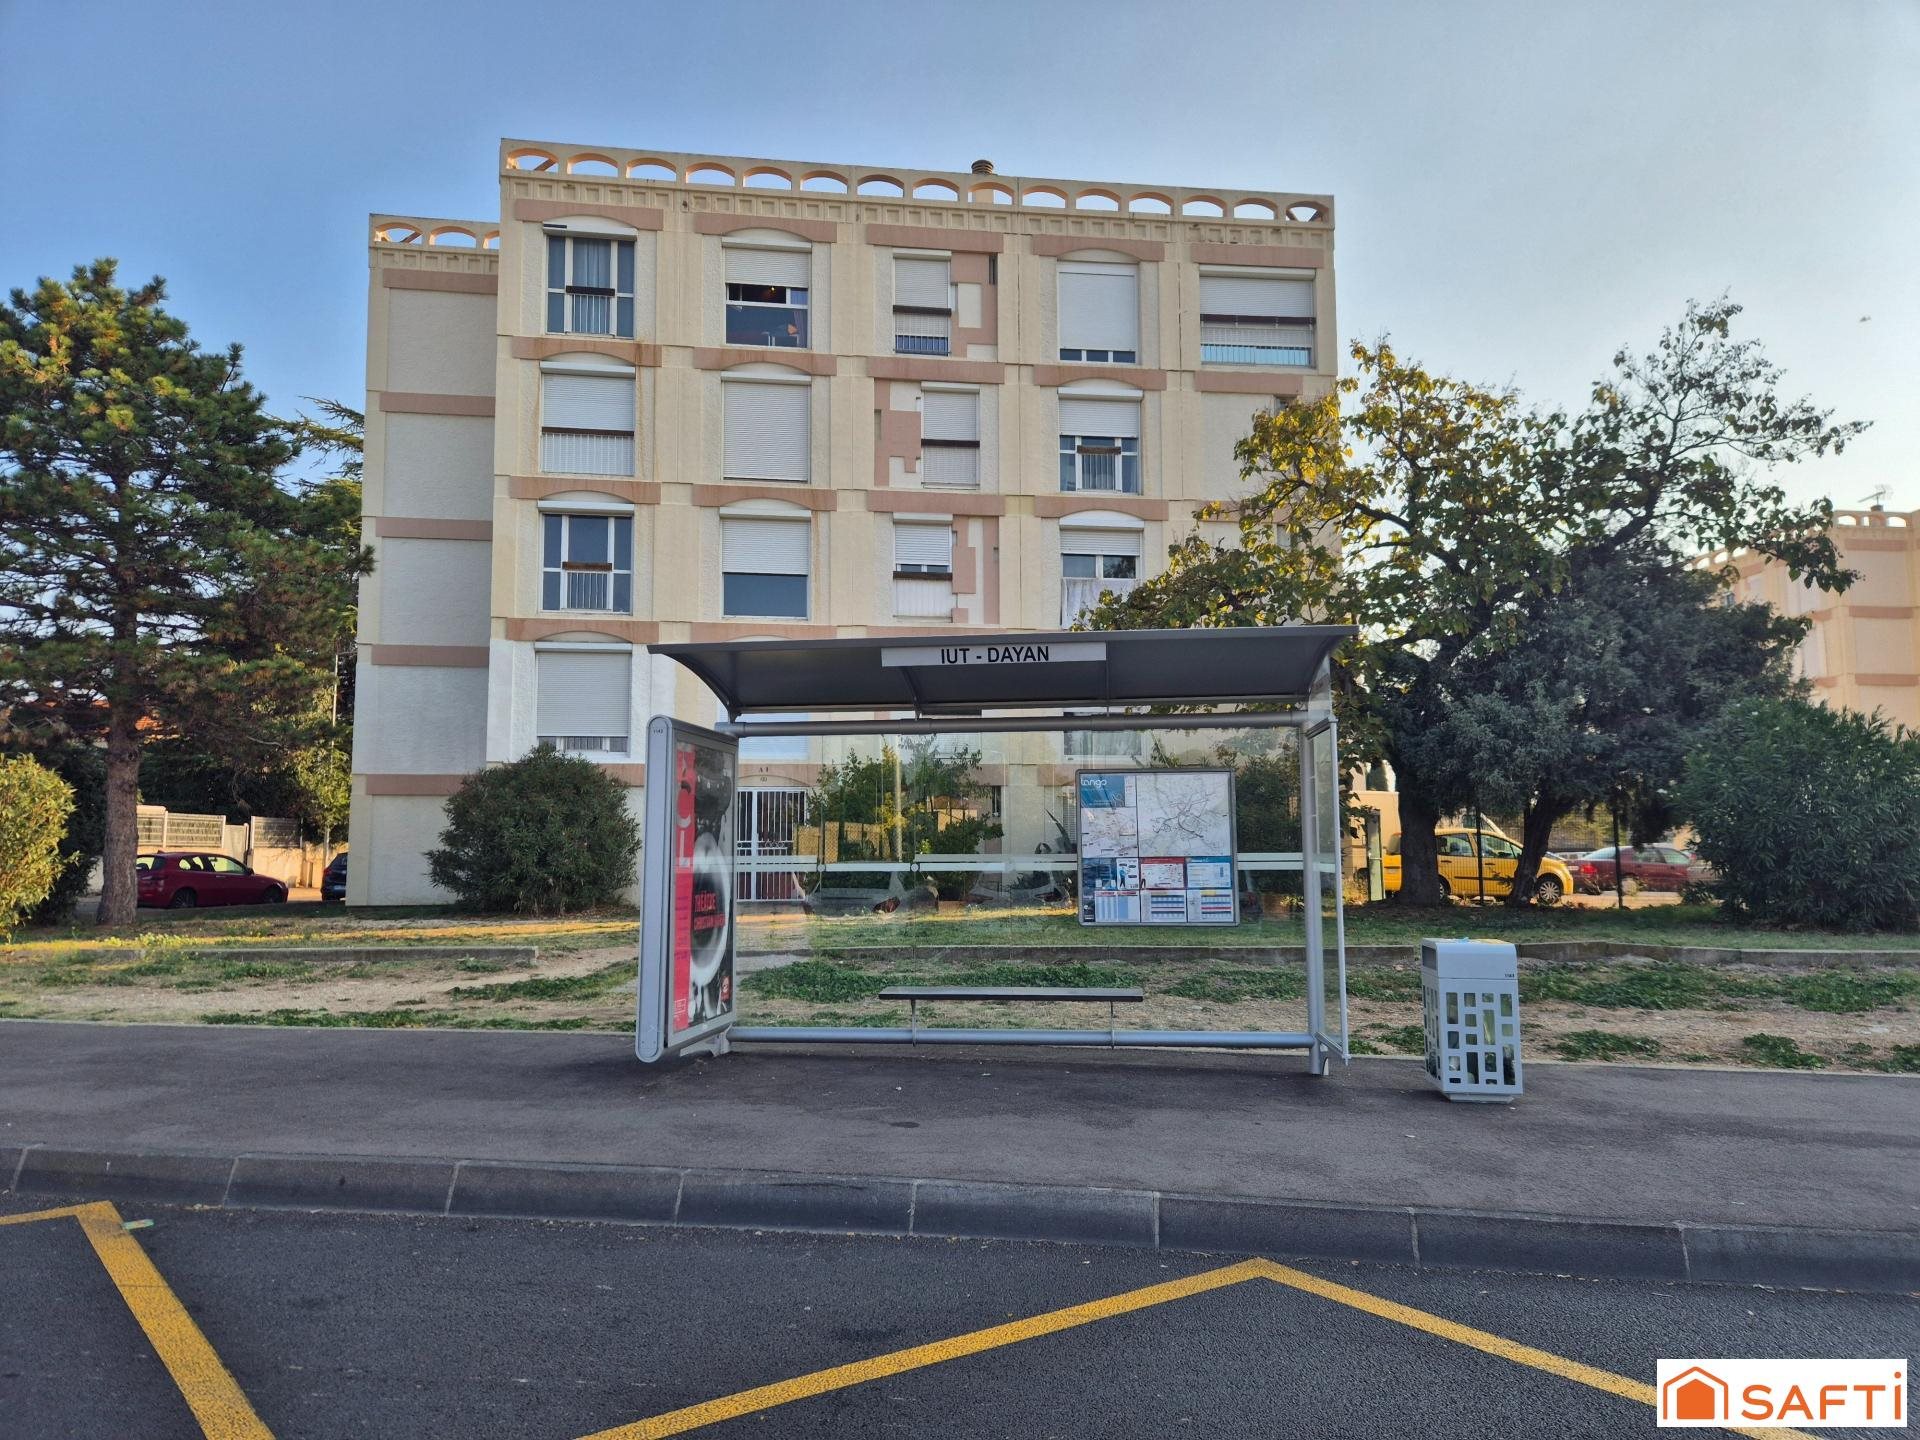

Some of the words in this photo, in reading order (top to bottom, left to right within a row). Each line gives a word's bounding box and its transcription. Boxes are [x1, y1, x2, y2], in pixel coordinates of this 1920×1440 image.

[941, 648, 970, 664] IUT
[987, 646, 1050, 663] DAYAN
[1080, 778, 1108, 789] tango
